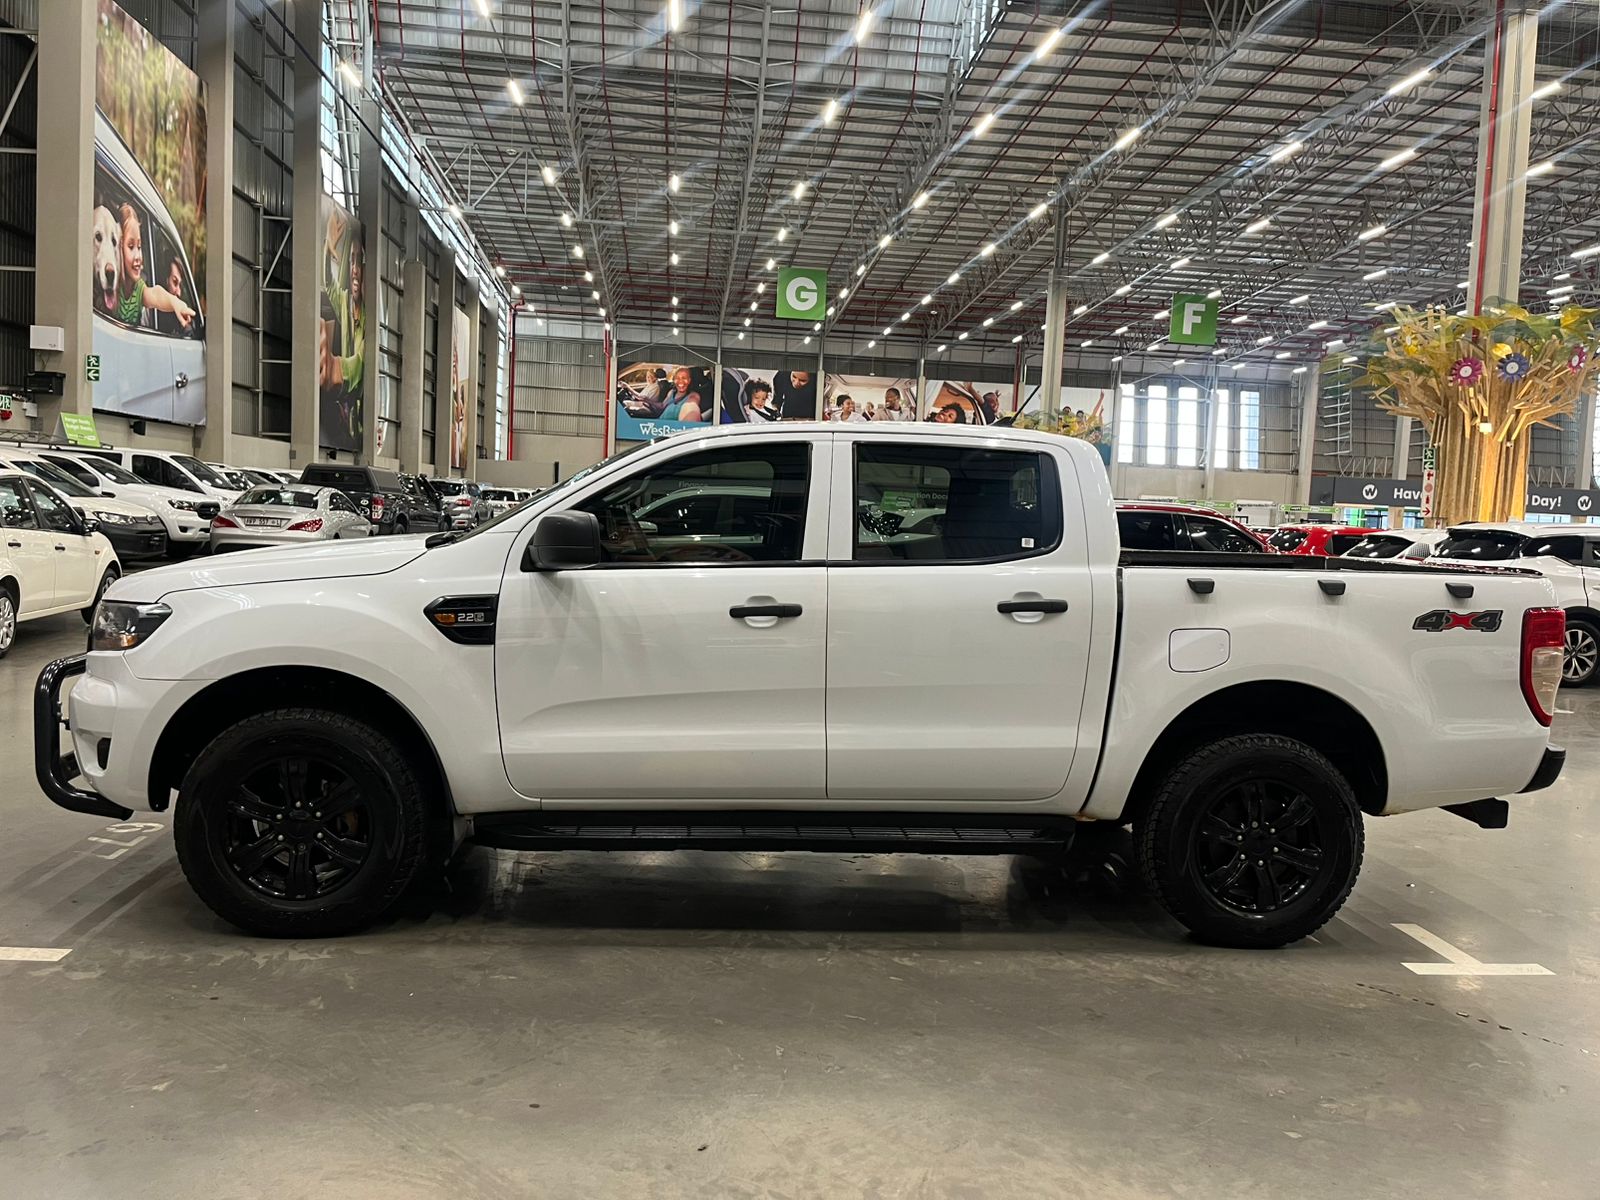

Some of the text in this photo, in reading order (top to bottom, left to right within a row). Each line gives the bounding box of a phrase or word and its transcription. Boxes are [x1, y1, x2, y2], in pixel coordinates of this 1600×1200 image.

[786, 277, 818, 311] G
[1182, 302, 1206, 335] F
[640, 422, 686, 437] WesB
[1531, 494, 1562, 510] Day!
